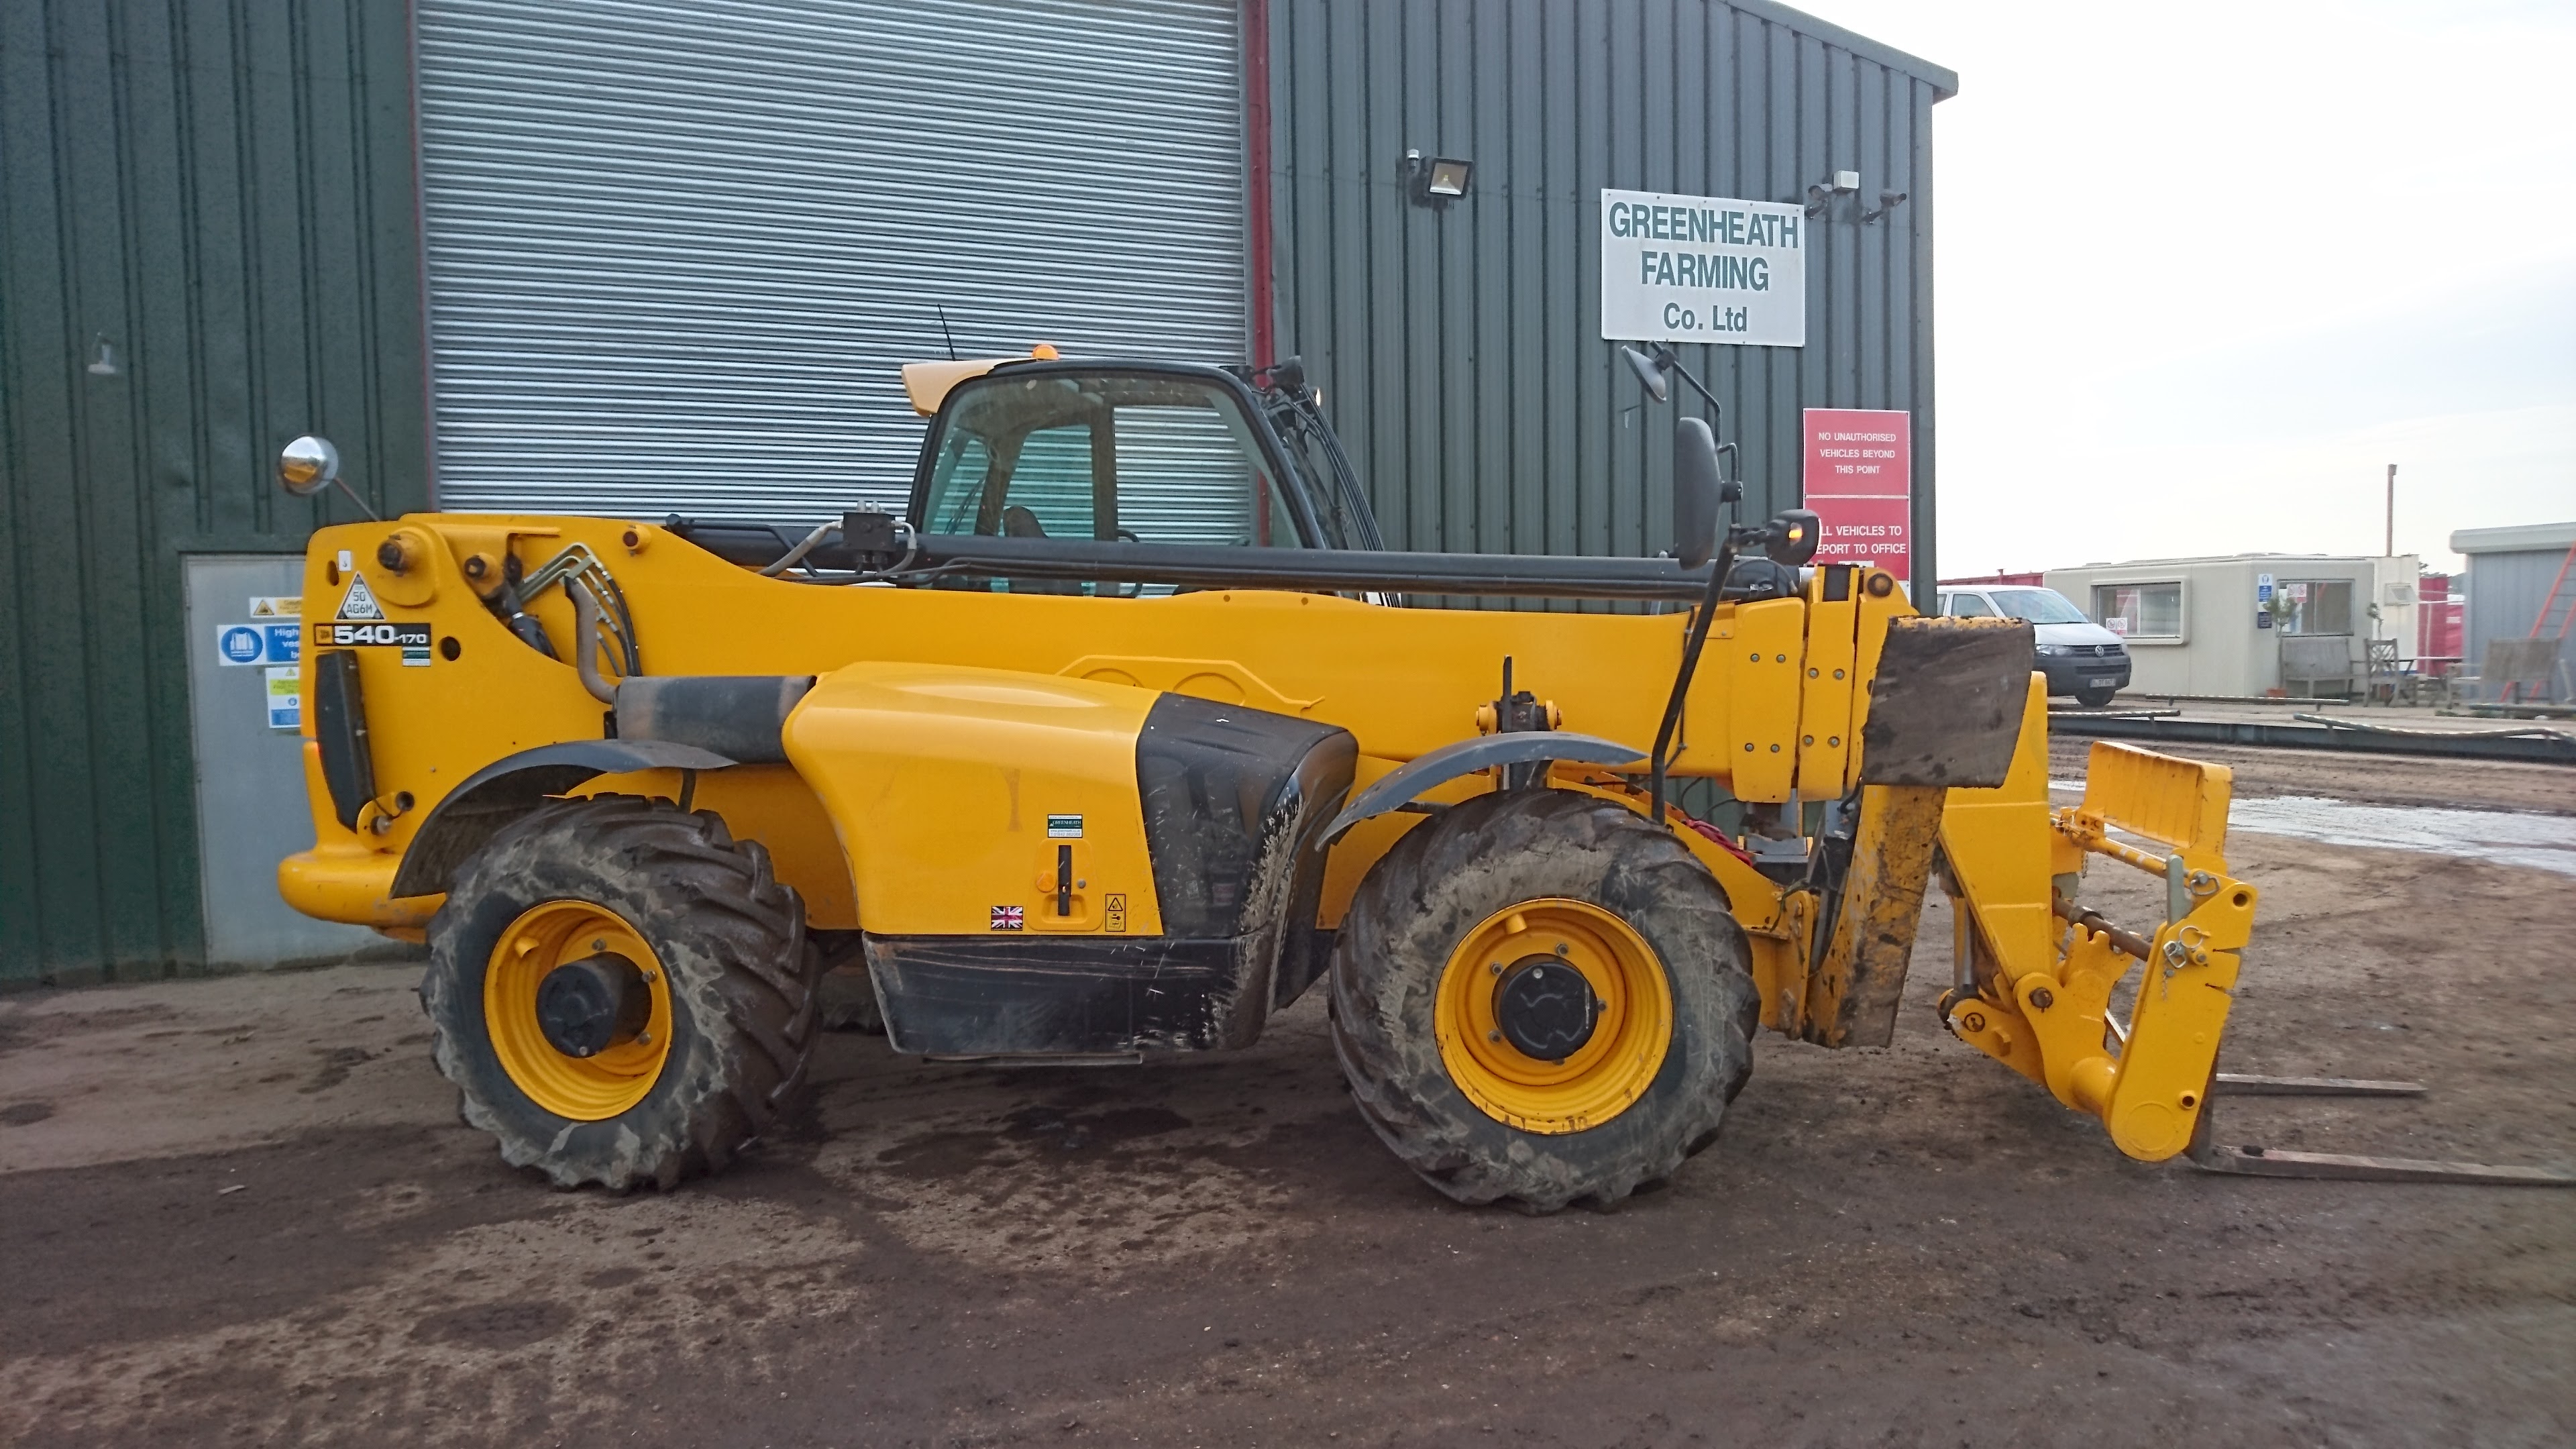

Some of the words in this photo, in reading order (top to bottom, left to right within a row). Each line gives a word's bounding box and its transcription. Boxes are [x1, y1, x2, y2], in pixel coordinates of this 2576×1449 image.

[1609, 201, 1799, 249] GREENHEATH
[1642, 250, 1769, 291] FARMING
[1664, 302, 1703, 330] Co.
[1713, 305, 1748, 332] Ltd
[1818, 432, 1831, 441] NO
[1834, 432, 1896, 443] UNAUTHORISED
[1819, 449, 1860, 458] VEHICLES
[1862, 449, 1896, 459] BEYOND
[1835, 465, 1854, 474] THIS
[1856, 466, 1881, 475] POINT
[1821, 525, 1833, 537] LL
[1835, 525, 1886, 537] VEHICLES
[1888, 525, 1902, 536] TO
[1816, 543, 1850, 555] EPORT
[1854, 543, 1868, 554] TO
[1870, 543, 1907, 555] OFFICE
[346, 604, 373, 614] AG6M
[334, 625, 427, 644] 540-170
